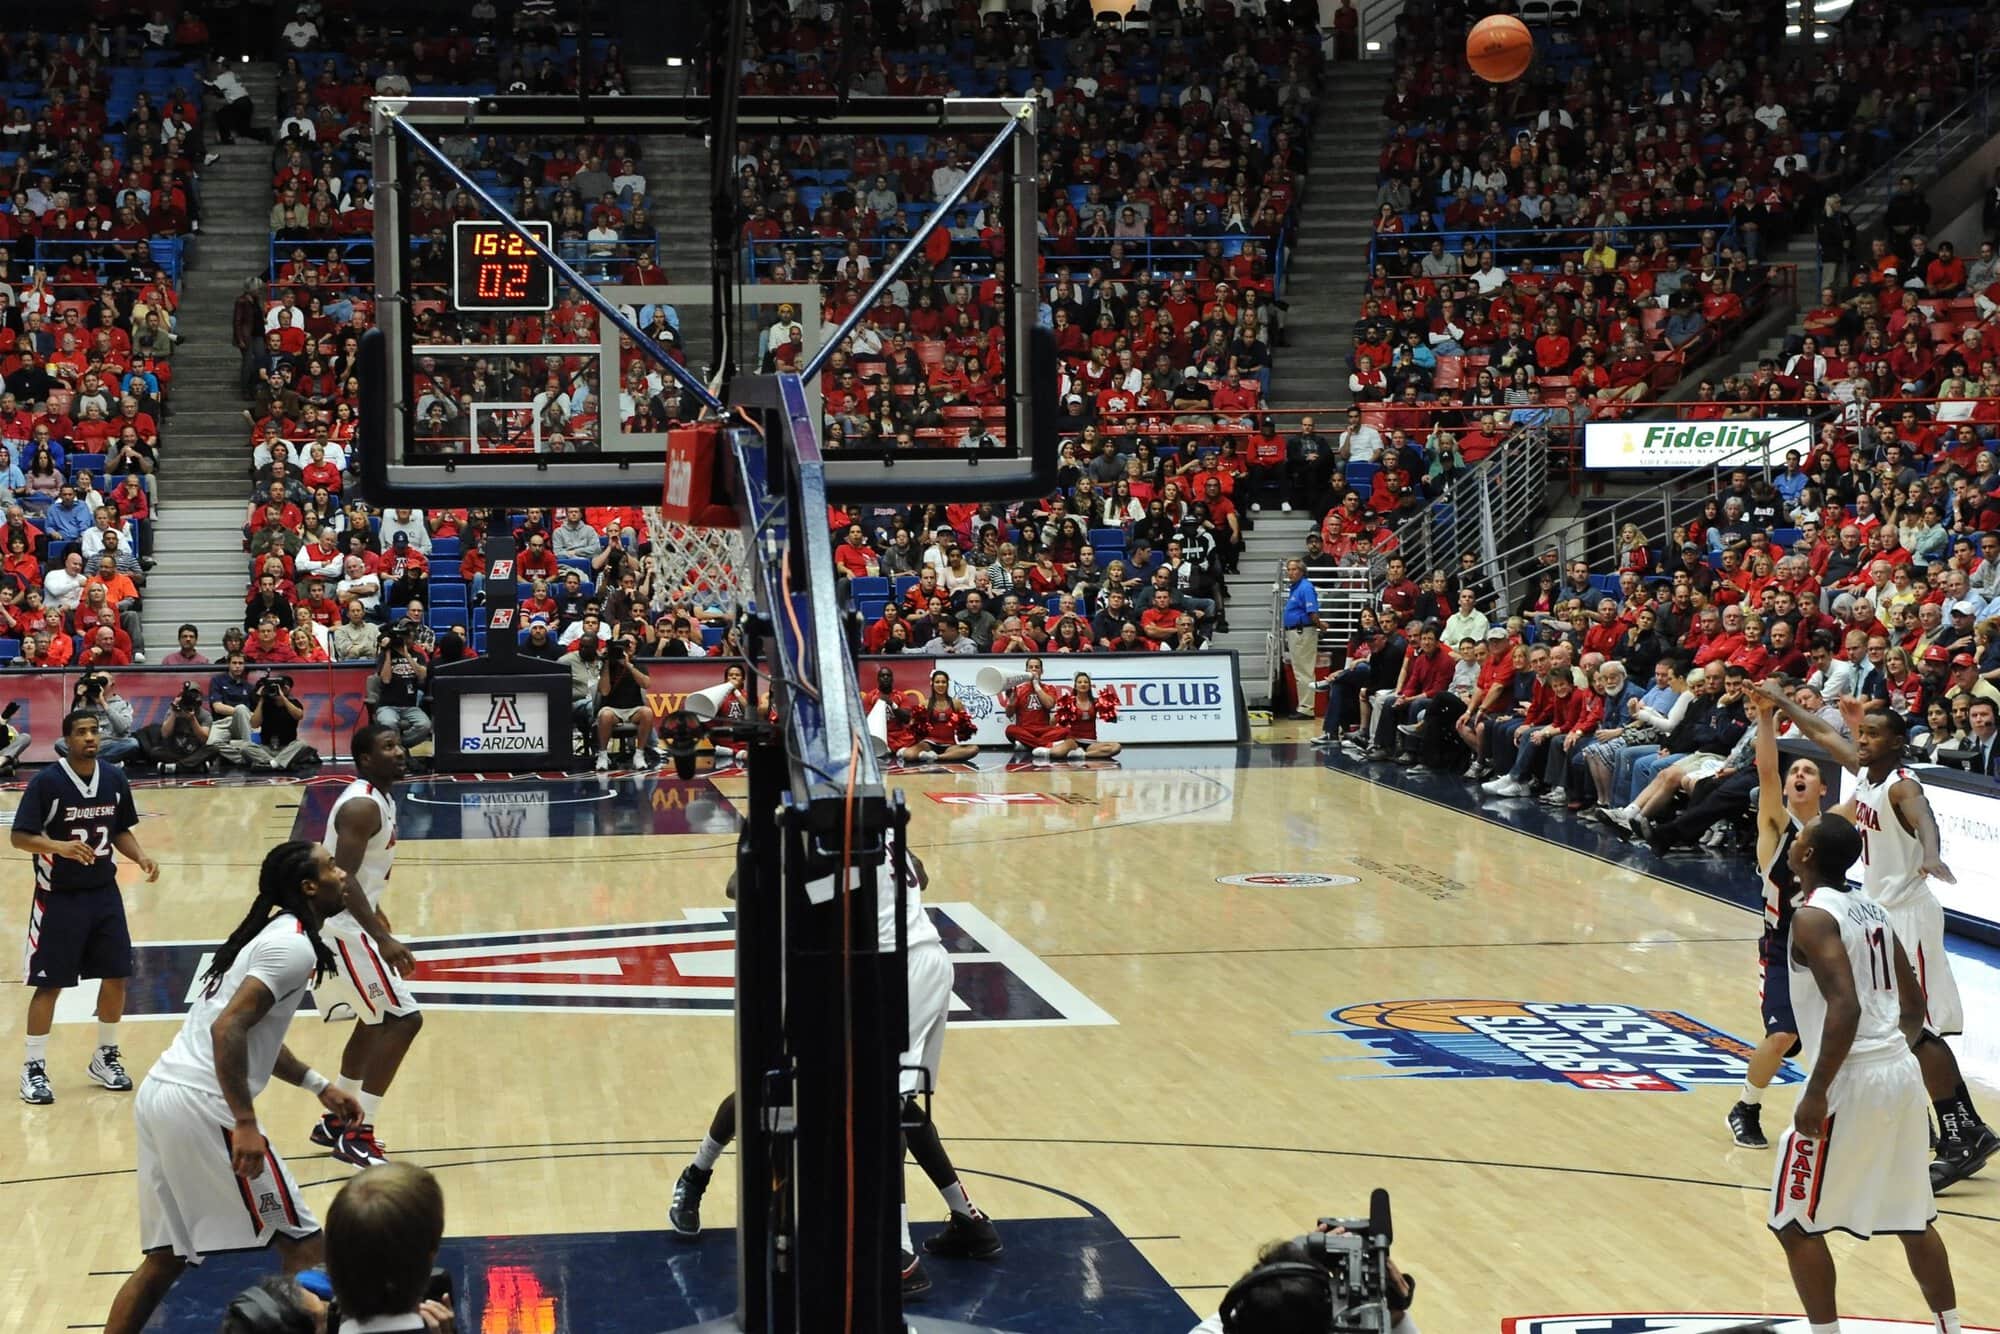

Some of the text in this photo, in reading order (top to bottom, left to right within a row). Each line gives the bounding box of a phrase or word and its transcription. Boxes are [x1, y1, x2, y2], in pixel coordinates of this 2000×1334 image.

[479, 264, 528, 297] 02
[1643, 426, 1771, 453] Fidelity
[481, 736, 544, 750] ARIZONA
[64, 805, 116, 821] DUQUESNE
[1864, 927, 1892, 990] 11
[1456, 1015, 1640, 1063] SPORTS
[1523, 1003, 1786, 1084] CLASSIC
[1582, 1073, 1663, 1090] 2K
[1790, 1139, 1815, 1201] CATS
